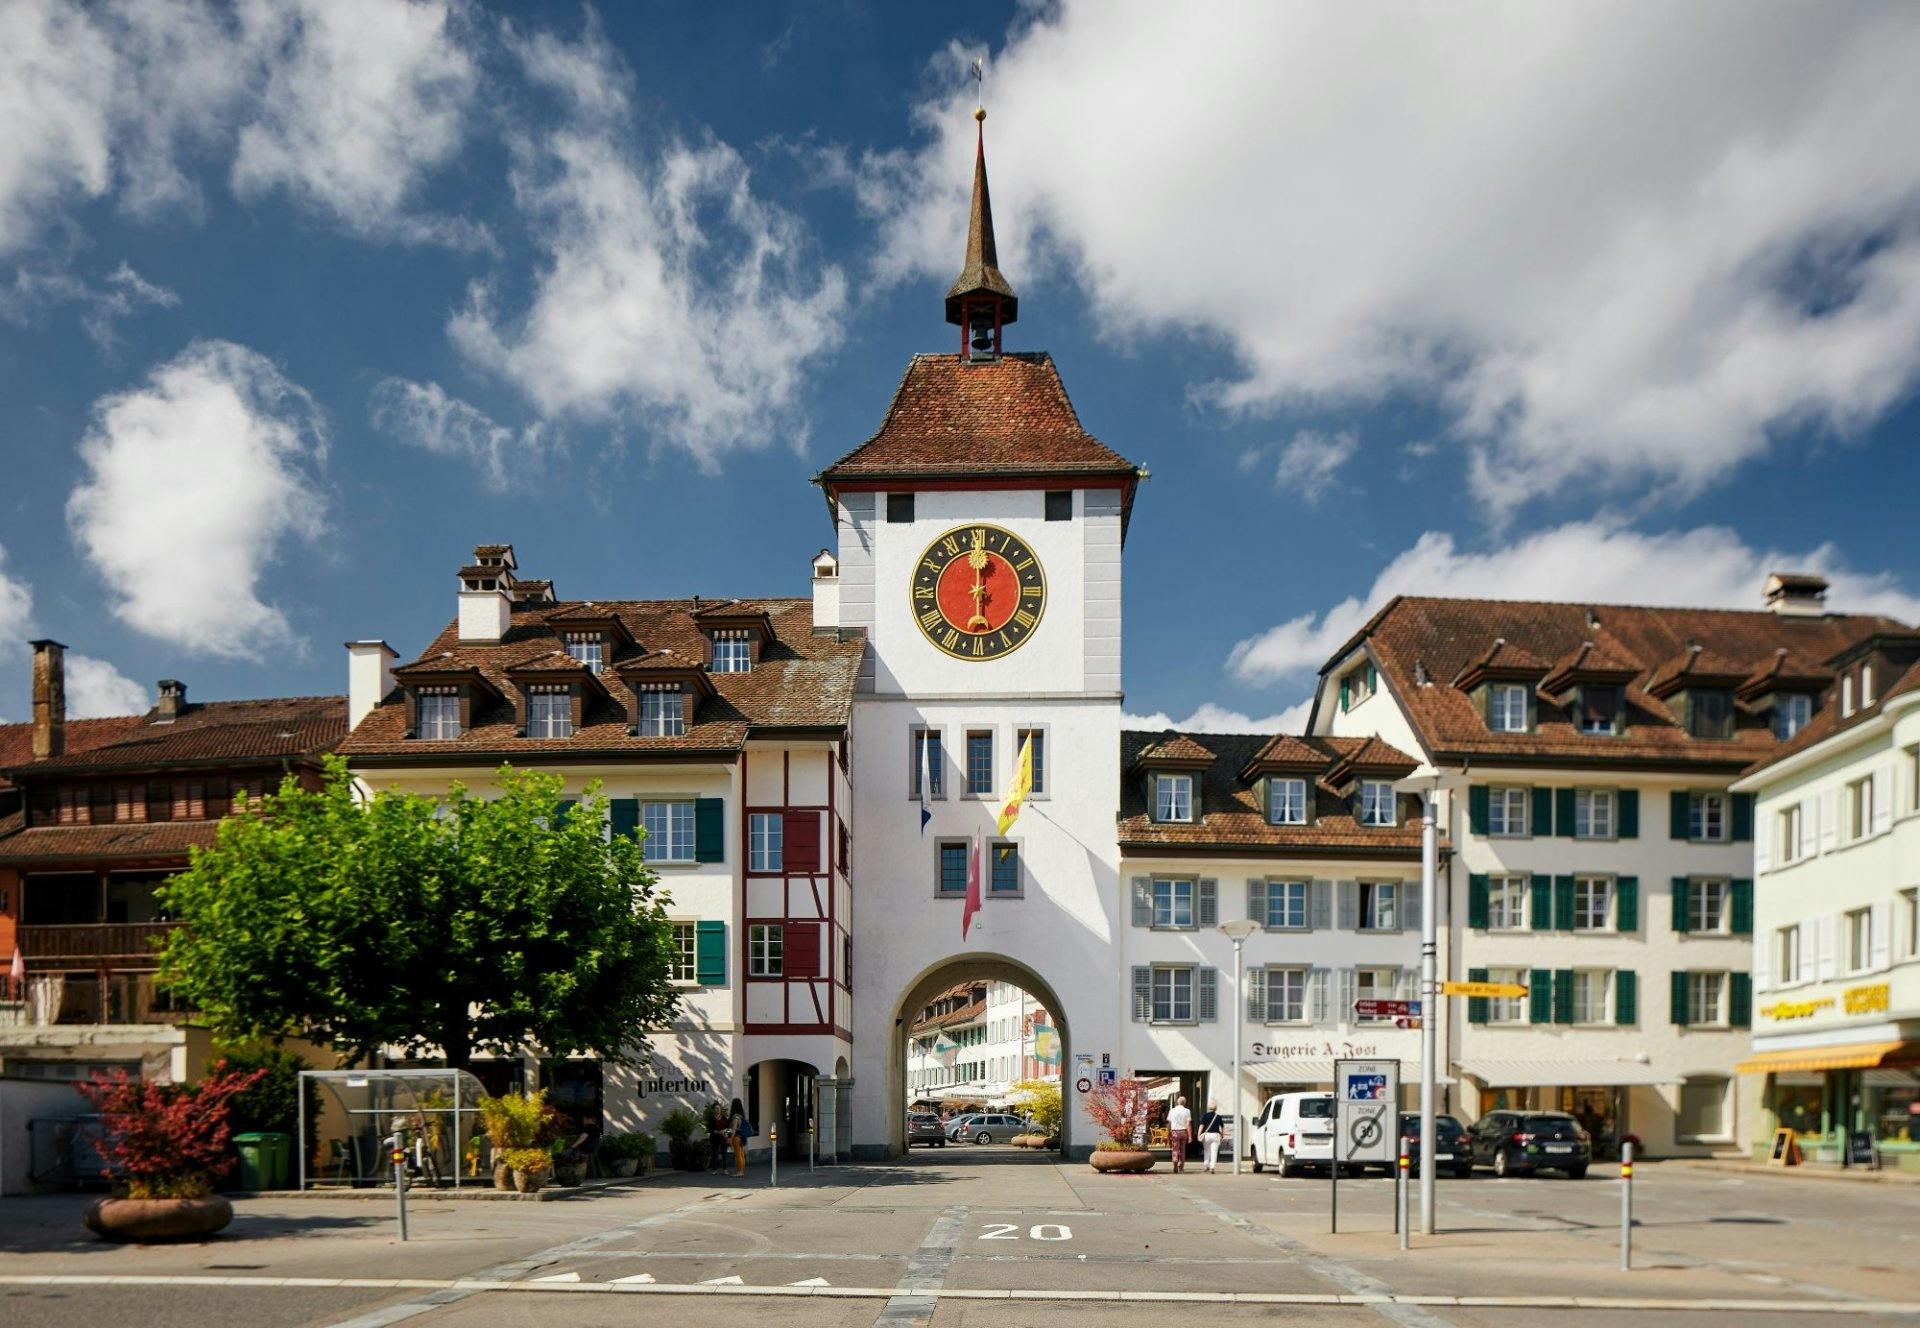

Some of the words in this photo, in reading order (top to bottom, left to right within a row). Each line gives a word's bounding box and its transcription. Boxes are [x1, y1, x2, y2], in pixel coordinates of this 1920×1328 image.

[1252, 1042, 1316, 1058] Drogerie
[1322, 1042, 1338, 1056] A.
[1343, 1042, 1377, 1060] Jost
[637, 1076, 710, 1099] Untertor
[977, 1223, 1073, 1241] 20
